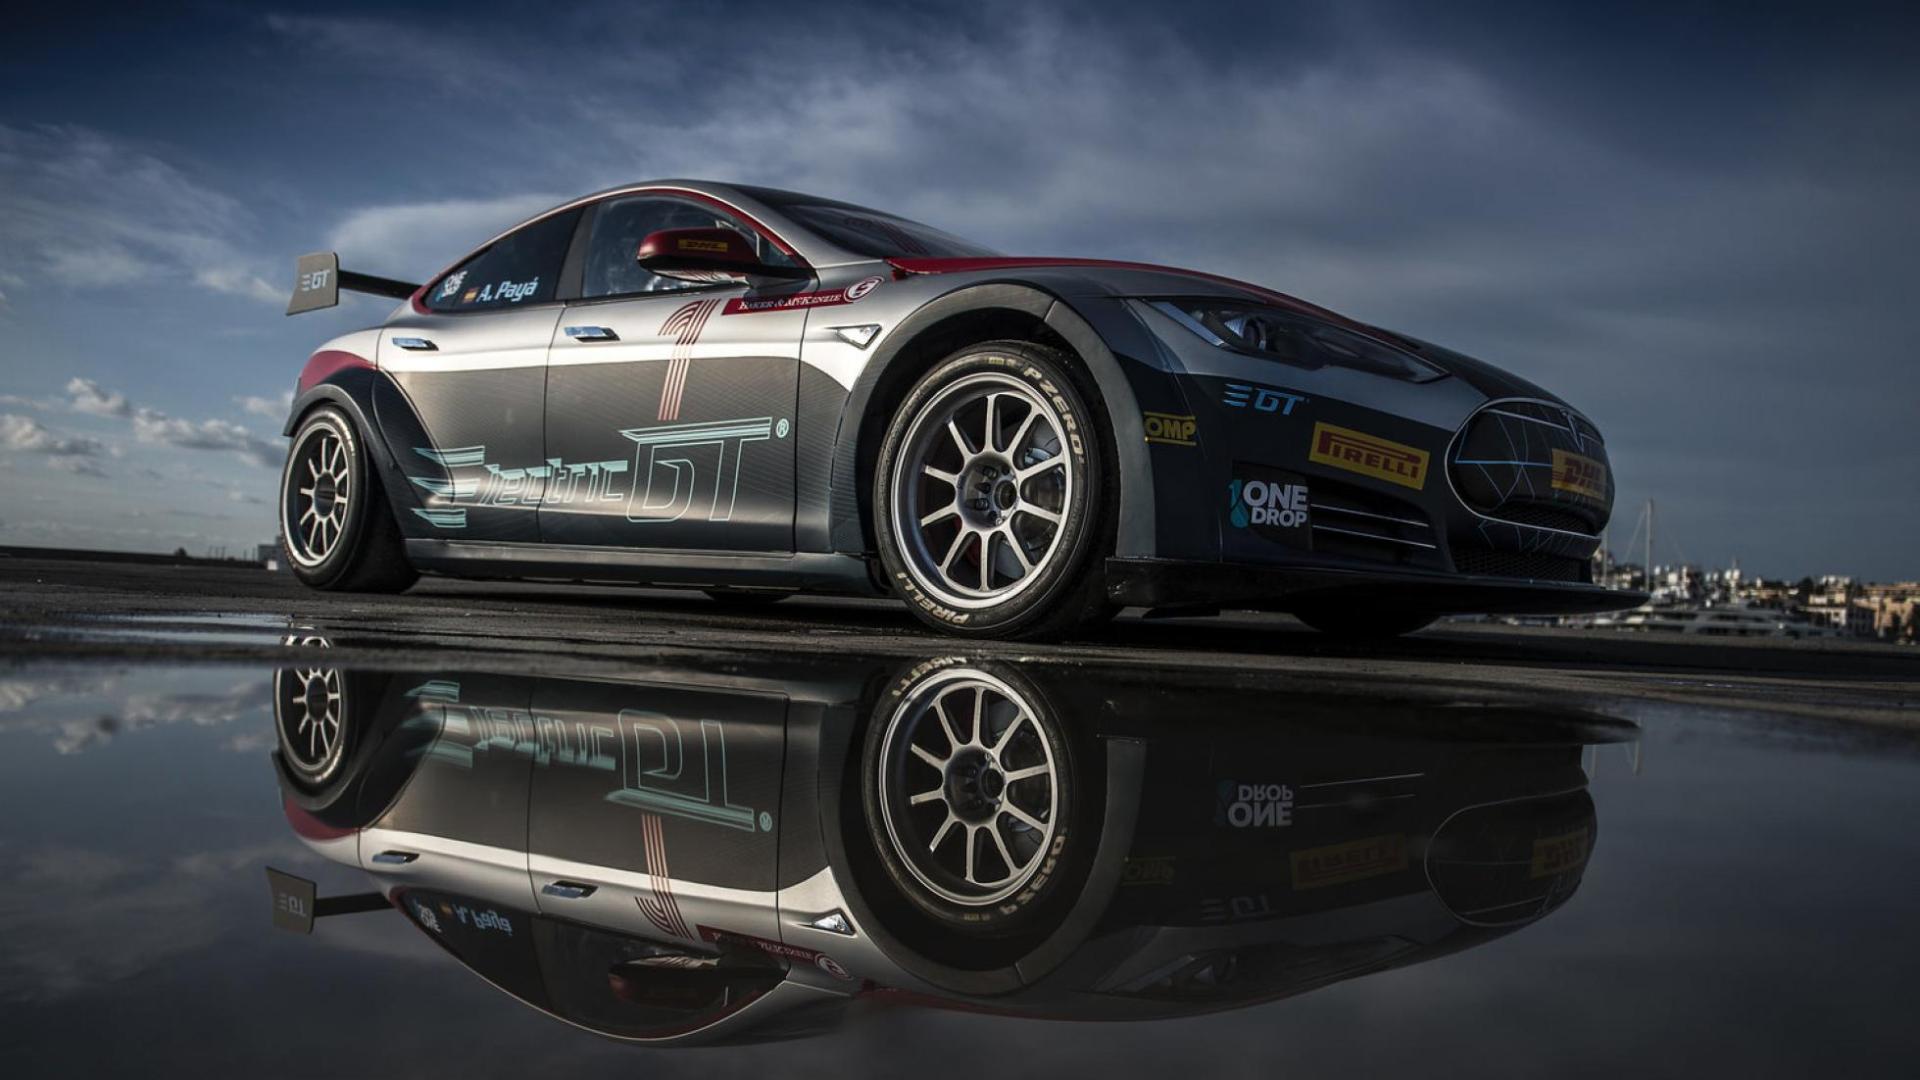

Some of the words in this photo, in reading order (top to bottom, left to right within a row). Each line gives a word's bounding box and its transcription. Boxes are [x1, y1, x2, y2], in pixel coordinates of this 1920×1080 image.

[476, 284, 493, 302] A.
[494, 276, 539, 302] Payá
[1023, 367, 1043, 380] P
[1039, 379, 1084, 455] ZERO
[1145, 417, 1196, 441] OMP
[1317, 430, 1422, 479] PIRELLI
[1564, 457, 1605, 492] DHL
[1243, 480, 1308, 511] ONE
[1251, 506, 1308, 528] DROP
[896, 572, 970, 624] PIRELLI
